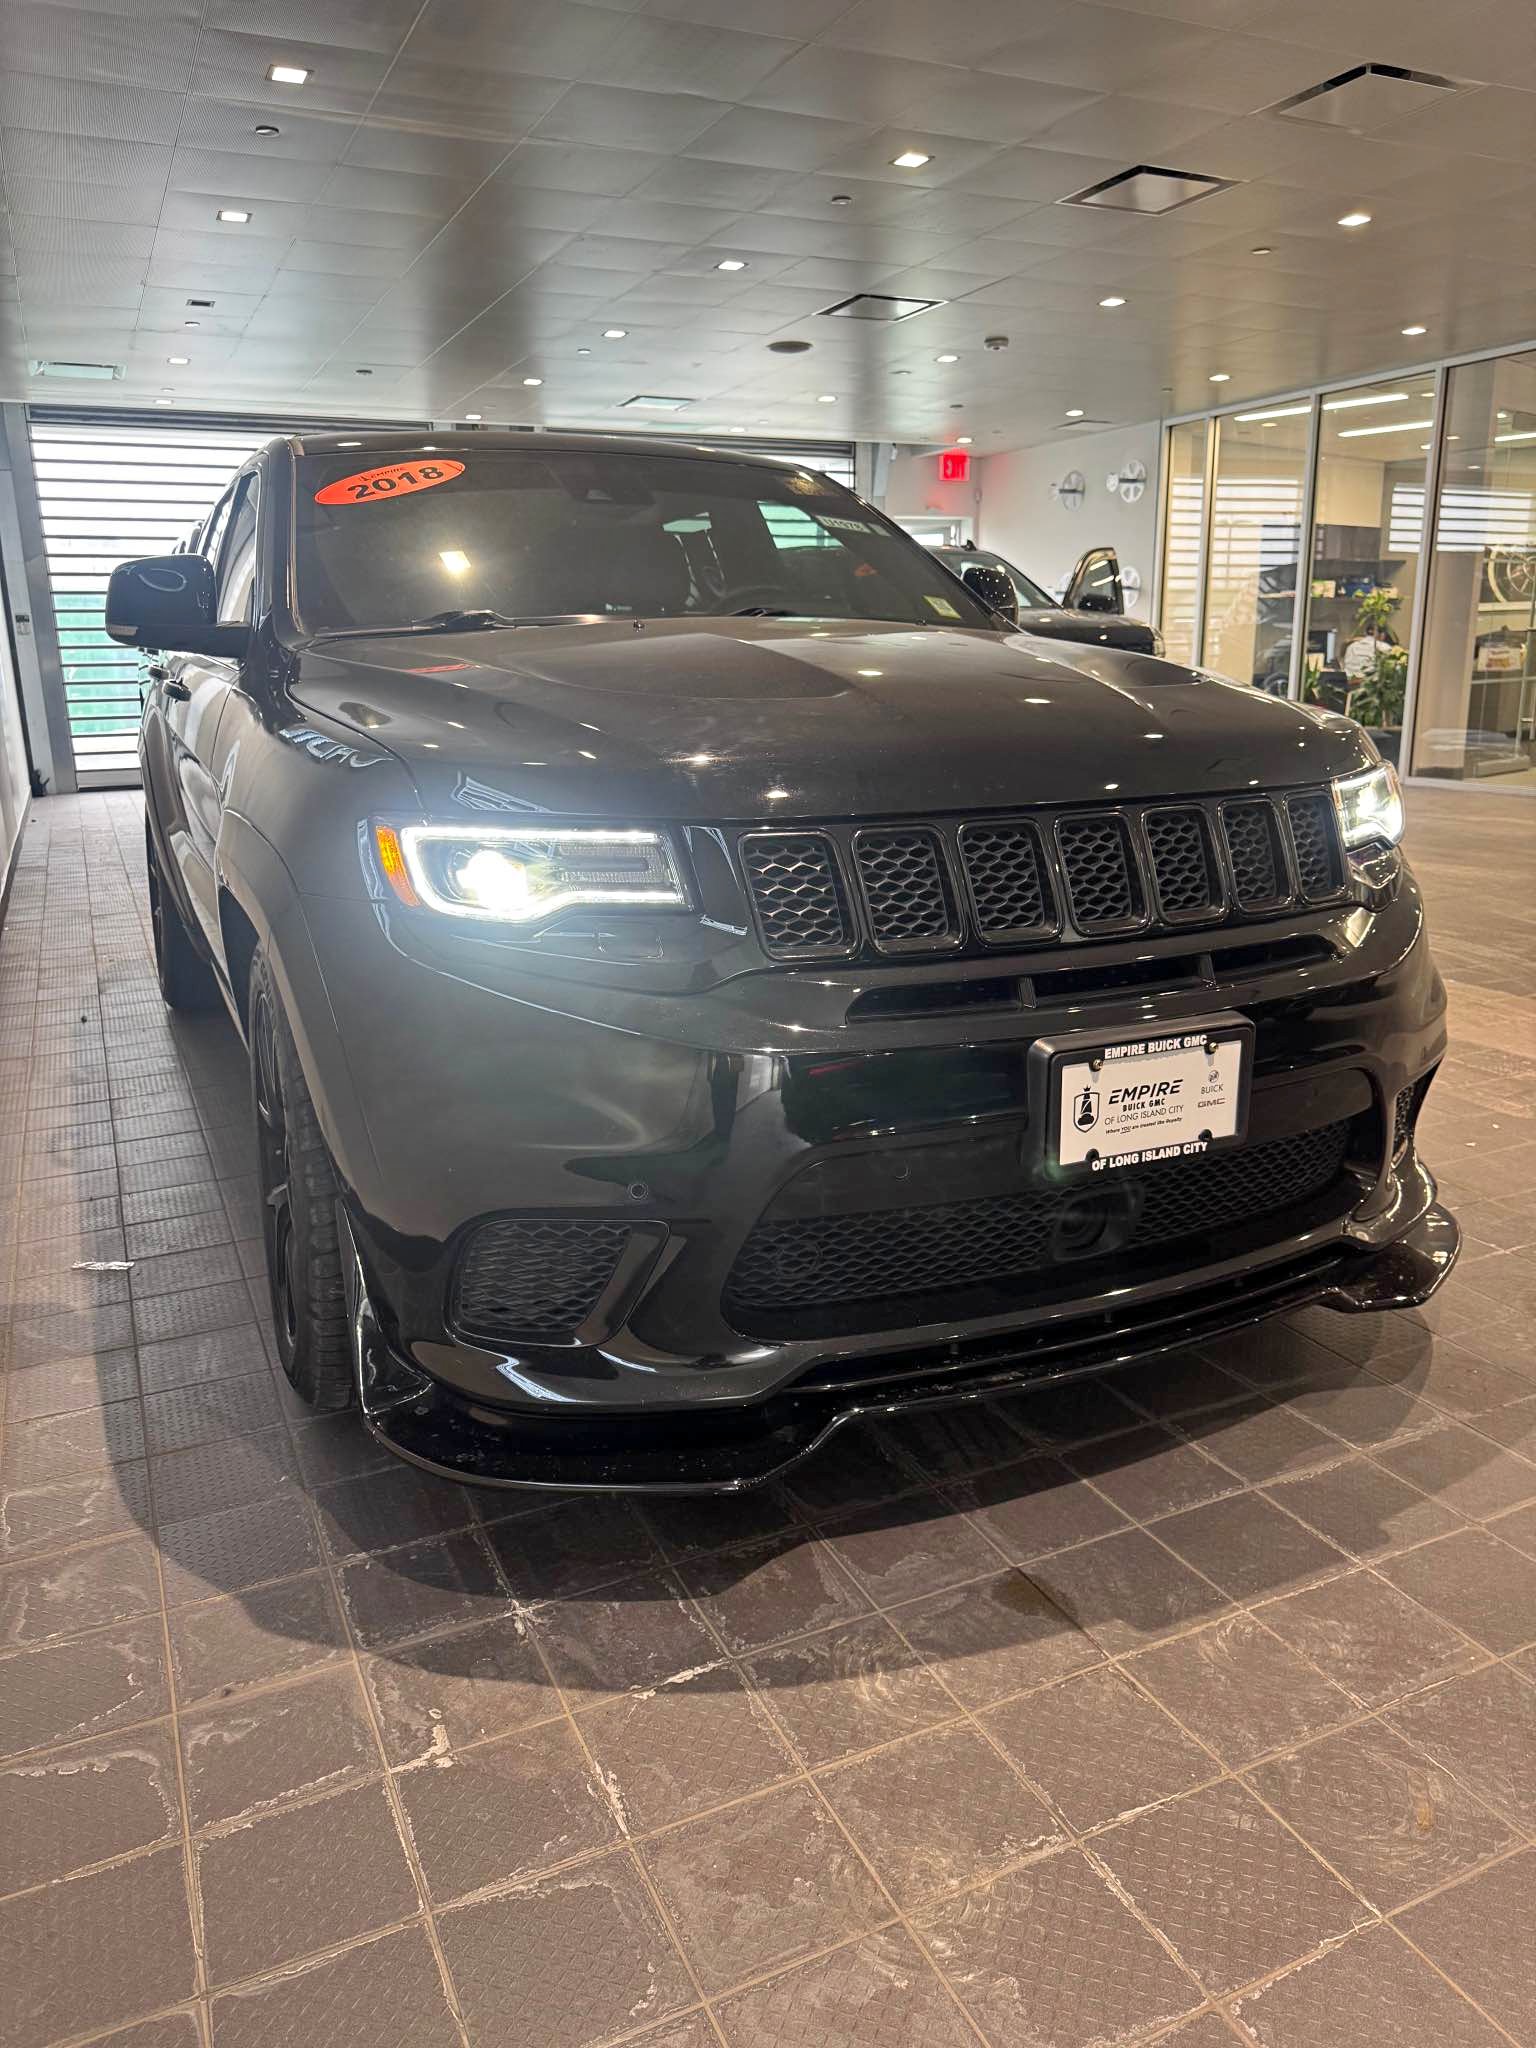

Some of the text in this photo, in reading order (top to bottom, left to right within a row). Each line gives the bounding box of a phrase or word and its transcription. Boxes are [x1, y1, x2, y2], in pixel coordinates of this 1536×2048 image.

[347, 467, 444, 499] 2018
[1104, 1034, 1208, 1059] EMPIRE BUICK GMC
[1108, 1079, 1183, 1105] EMPIRE
[1201, 1083, 1224, 1095] BUICK
[1122, 1098, 1166, 1112] BUICK GMC
[1197, 1097, 1226, 1108] GMC
[1104, 1104, 1184, 1126] OF LONG ISLAND CITY
[1091, 1141, 1208, 1172] OF LONG ISLAND CITY
